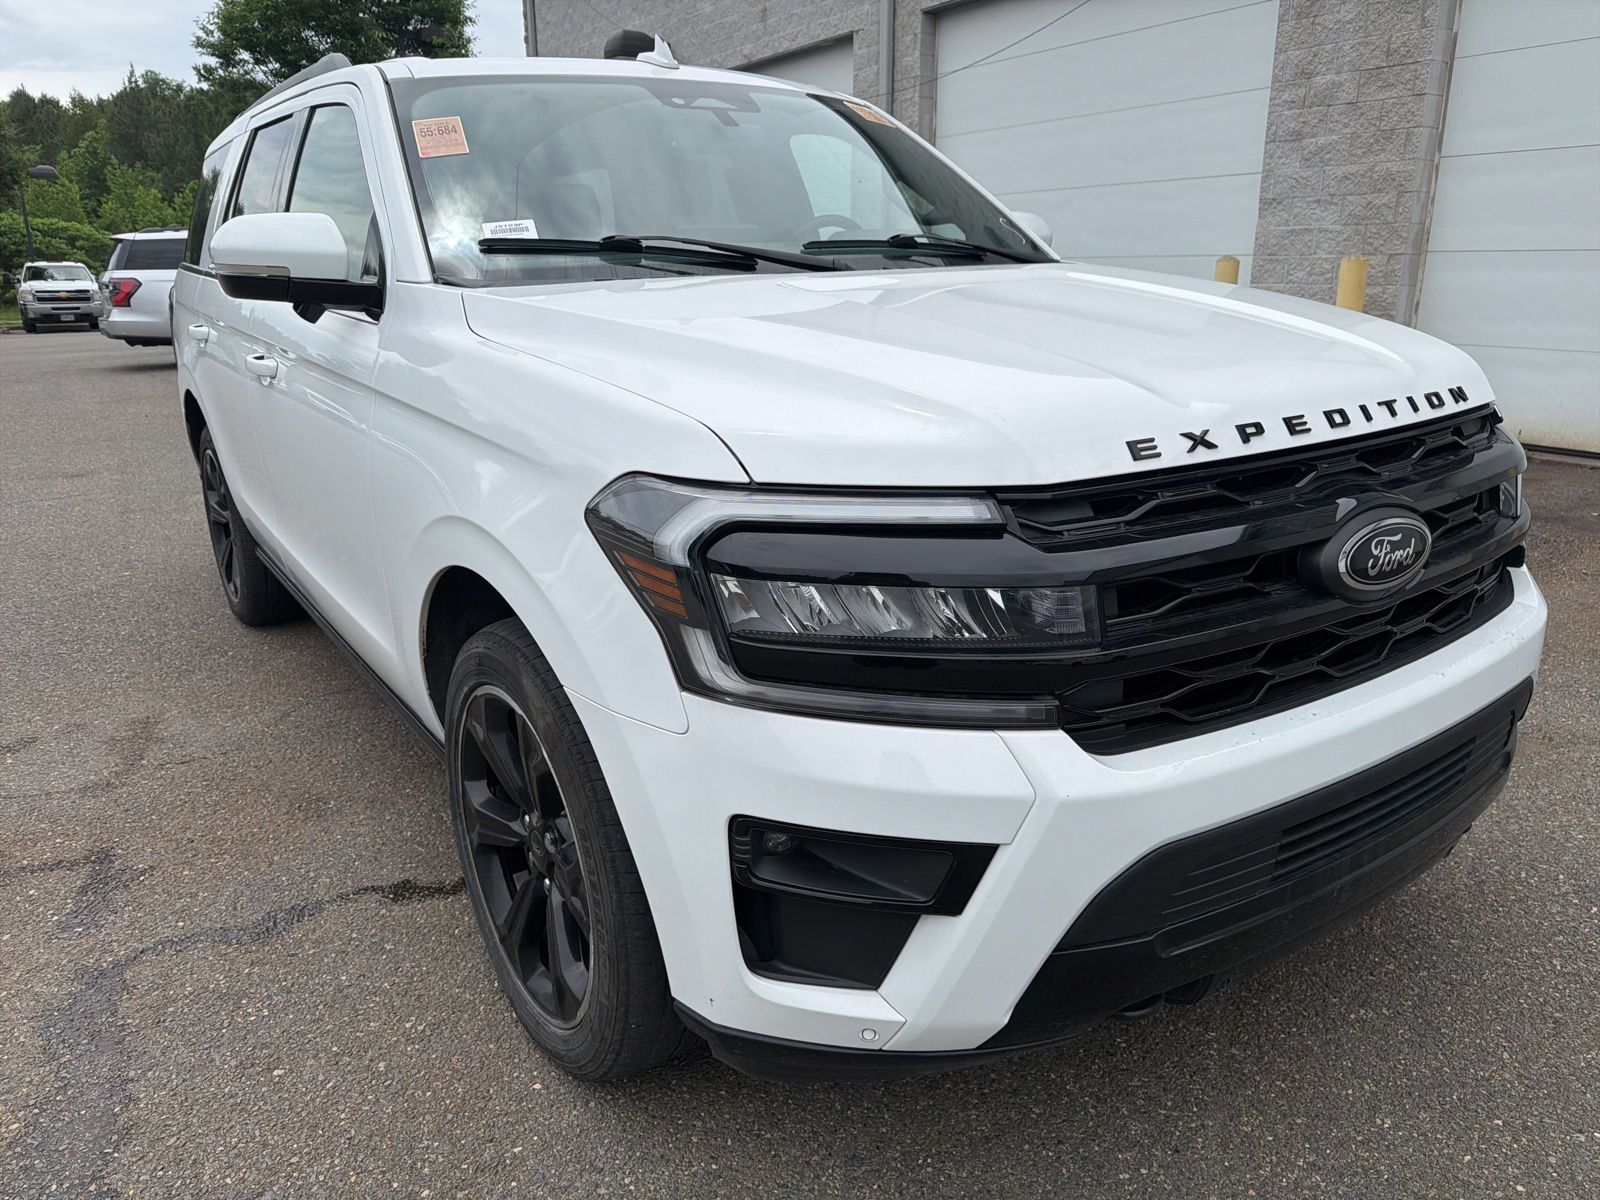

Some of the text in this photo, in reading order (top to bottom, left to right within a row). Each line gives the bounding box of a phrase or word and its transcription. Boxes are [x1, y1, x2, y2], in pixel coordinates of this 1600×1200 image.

[419, 125, 458, 138] 55:684
[1125, 385, 1470, 462] EXPEDITION
[1367, 532, 1416, 577] Ford
